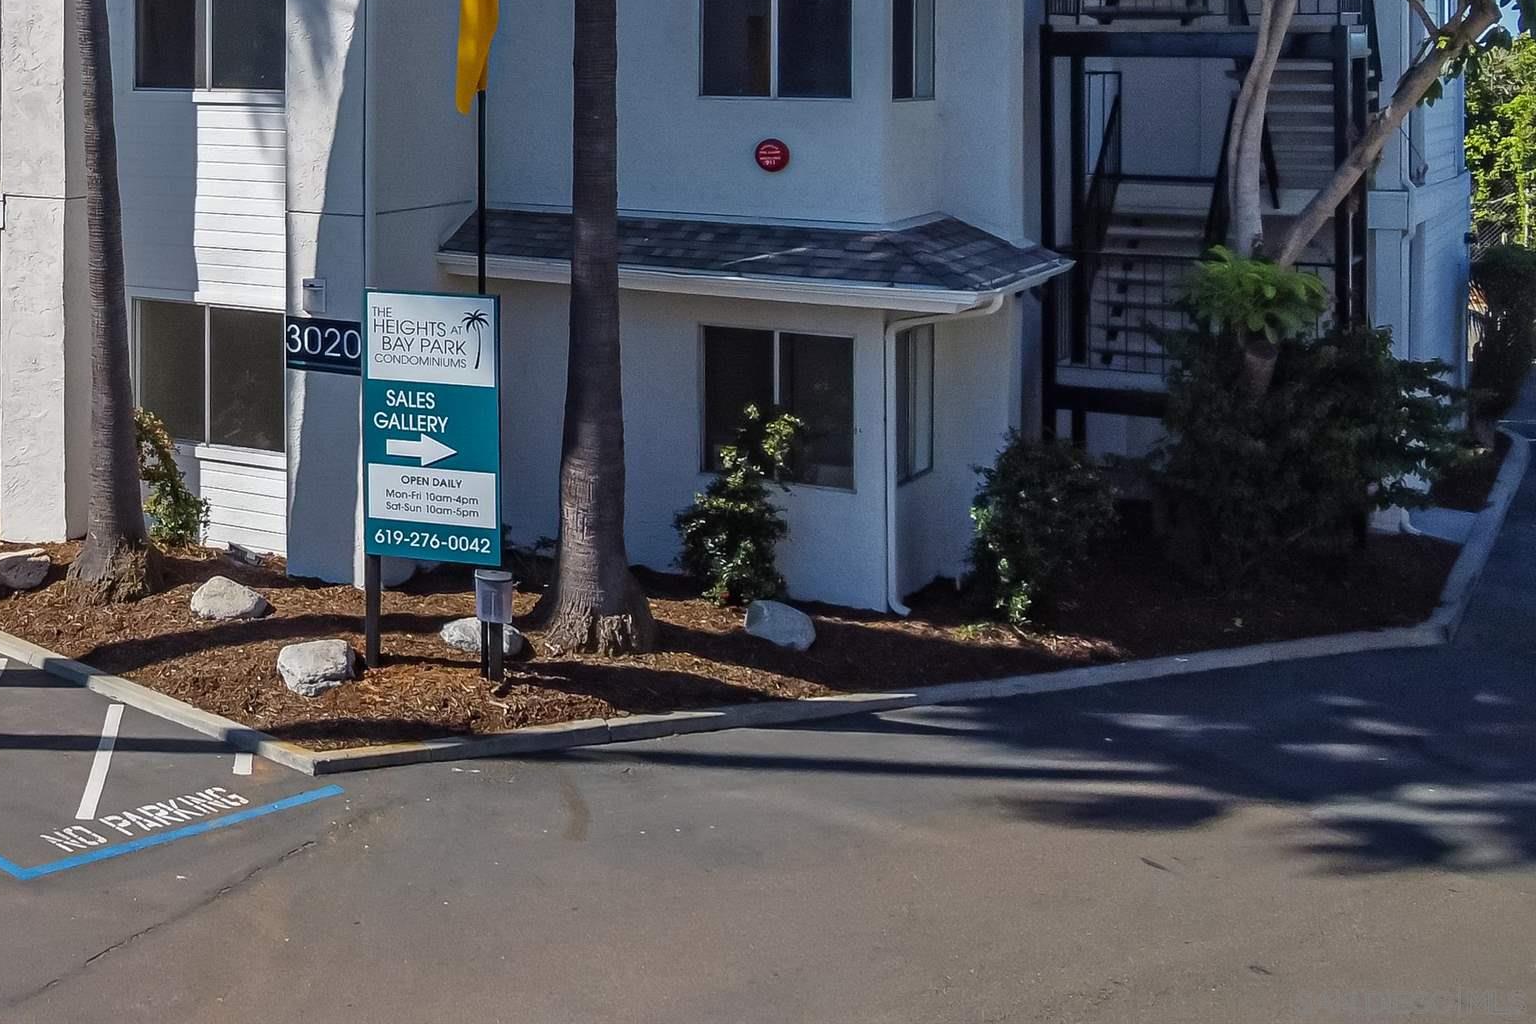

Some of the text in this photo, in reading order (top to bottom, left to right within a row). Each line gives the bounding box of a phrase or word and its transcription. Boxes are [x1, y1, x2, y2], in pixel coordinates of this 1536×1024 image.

[372, 306, 393, 318] THE
[373, 319, 463, 337] HEIGHTS AT
[286, 324, 361, 360] 3020
[382, 336, 467, 356] BAY PARK
[374, 354, 467, 369] CONDOMINIUMS
[386, 389, 436, 410] SALES
[374, 412, 449, 434] GALLERY
[401, 475, 462, 489] OPEN DAILY
[385, 489, 479, 506] Mon-Fri 10am-4pm
[385, 501, 480, 519] Sat-Sun 10am-5pm
[374, 529, 491, 554] 619-276-0042
[39, 787, 250, 852] NO PARKING
